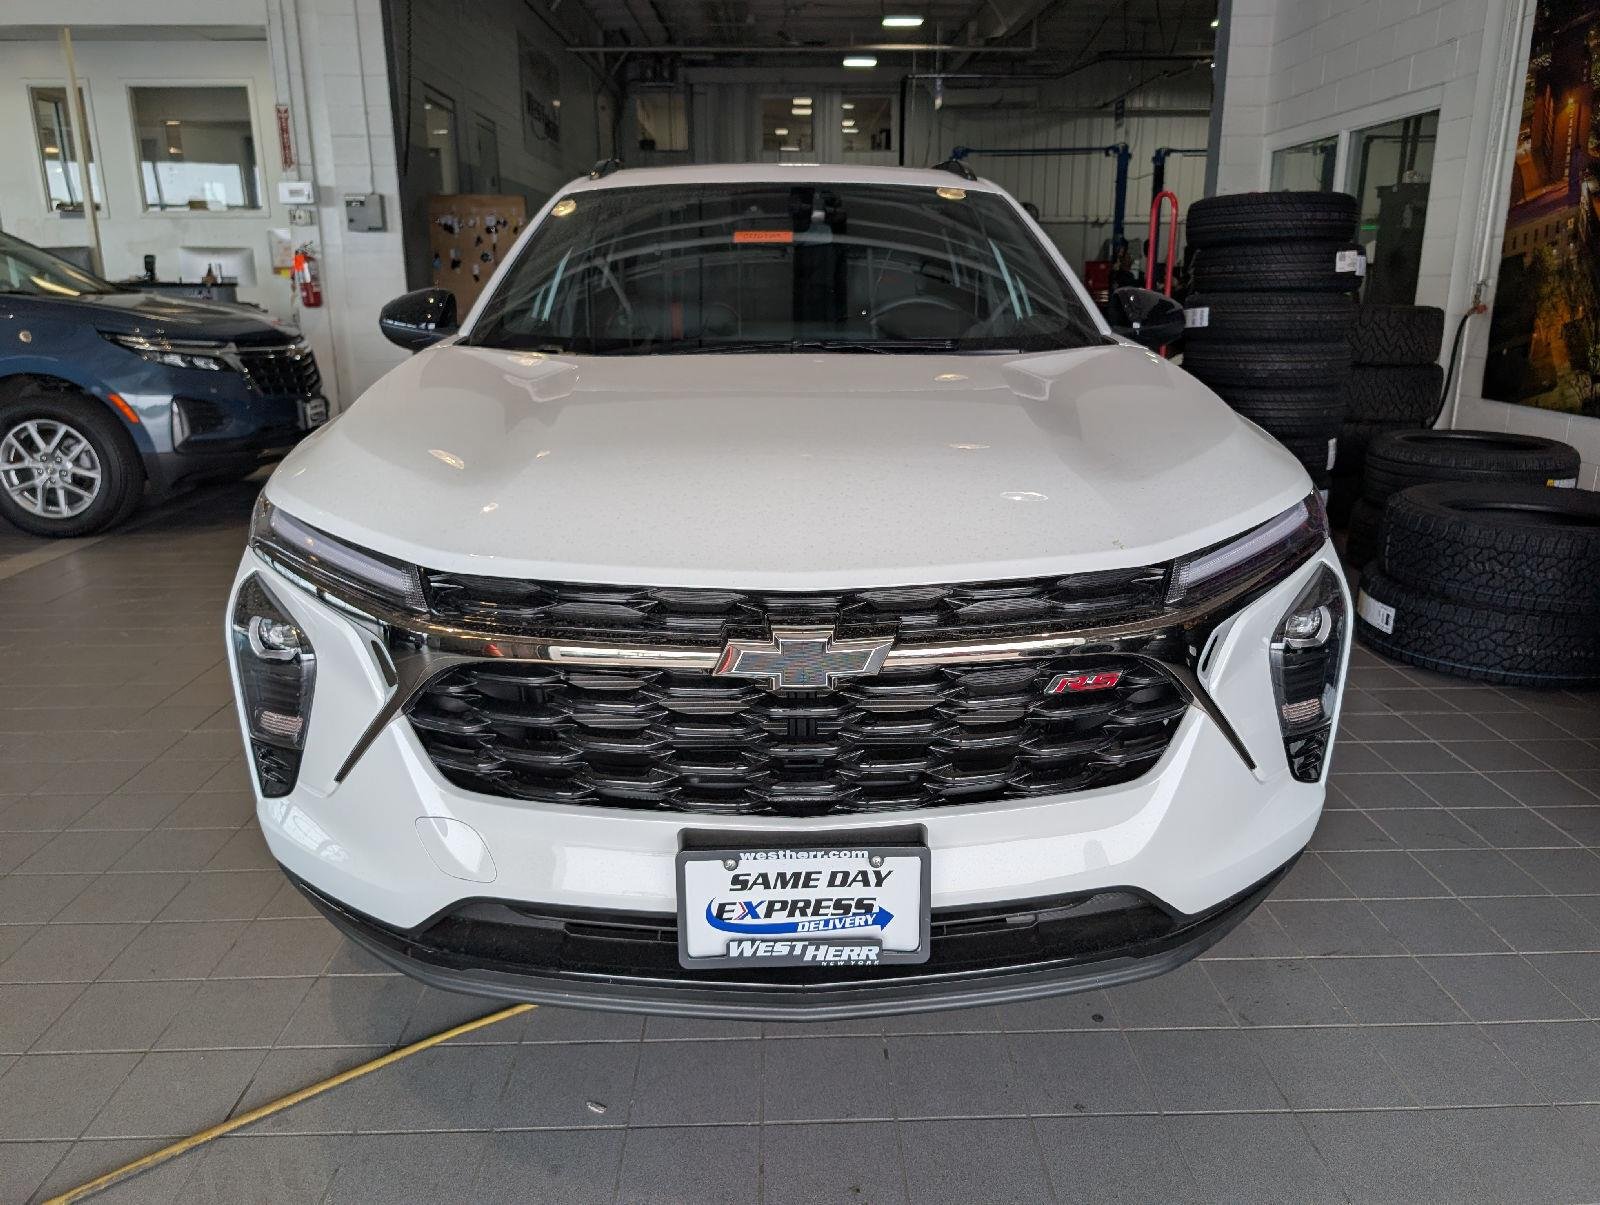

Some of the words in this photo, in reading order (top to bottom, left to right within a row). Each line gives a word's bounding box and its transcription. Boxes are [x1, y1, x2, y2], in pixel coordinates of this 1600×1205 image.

[1044, 672, 1122, 693] RS
[739, 850, 869, 861] westherr.com
[729, 870, 823, 892] SAME
[826, 869, 894, 888] DAY
[715, 897, 877, 921] EXPRESS
[797, 914, 876, 933] DELIVERY
